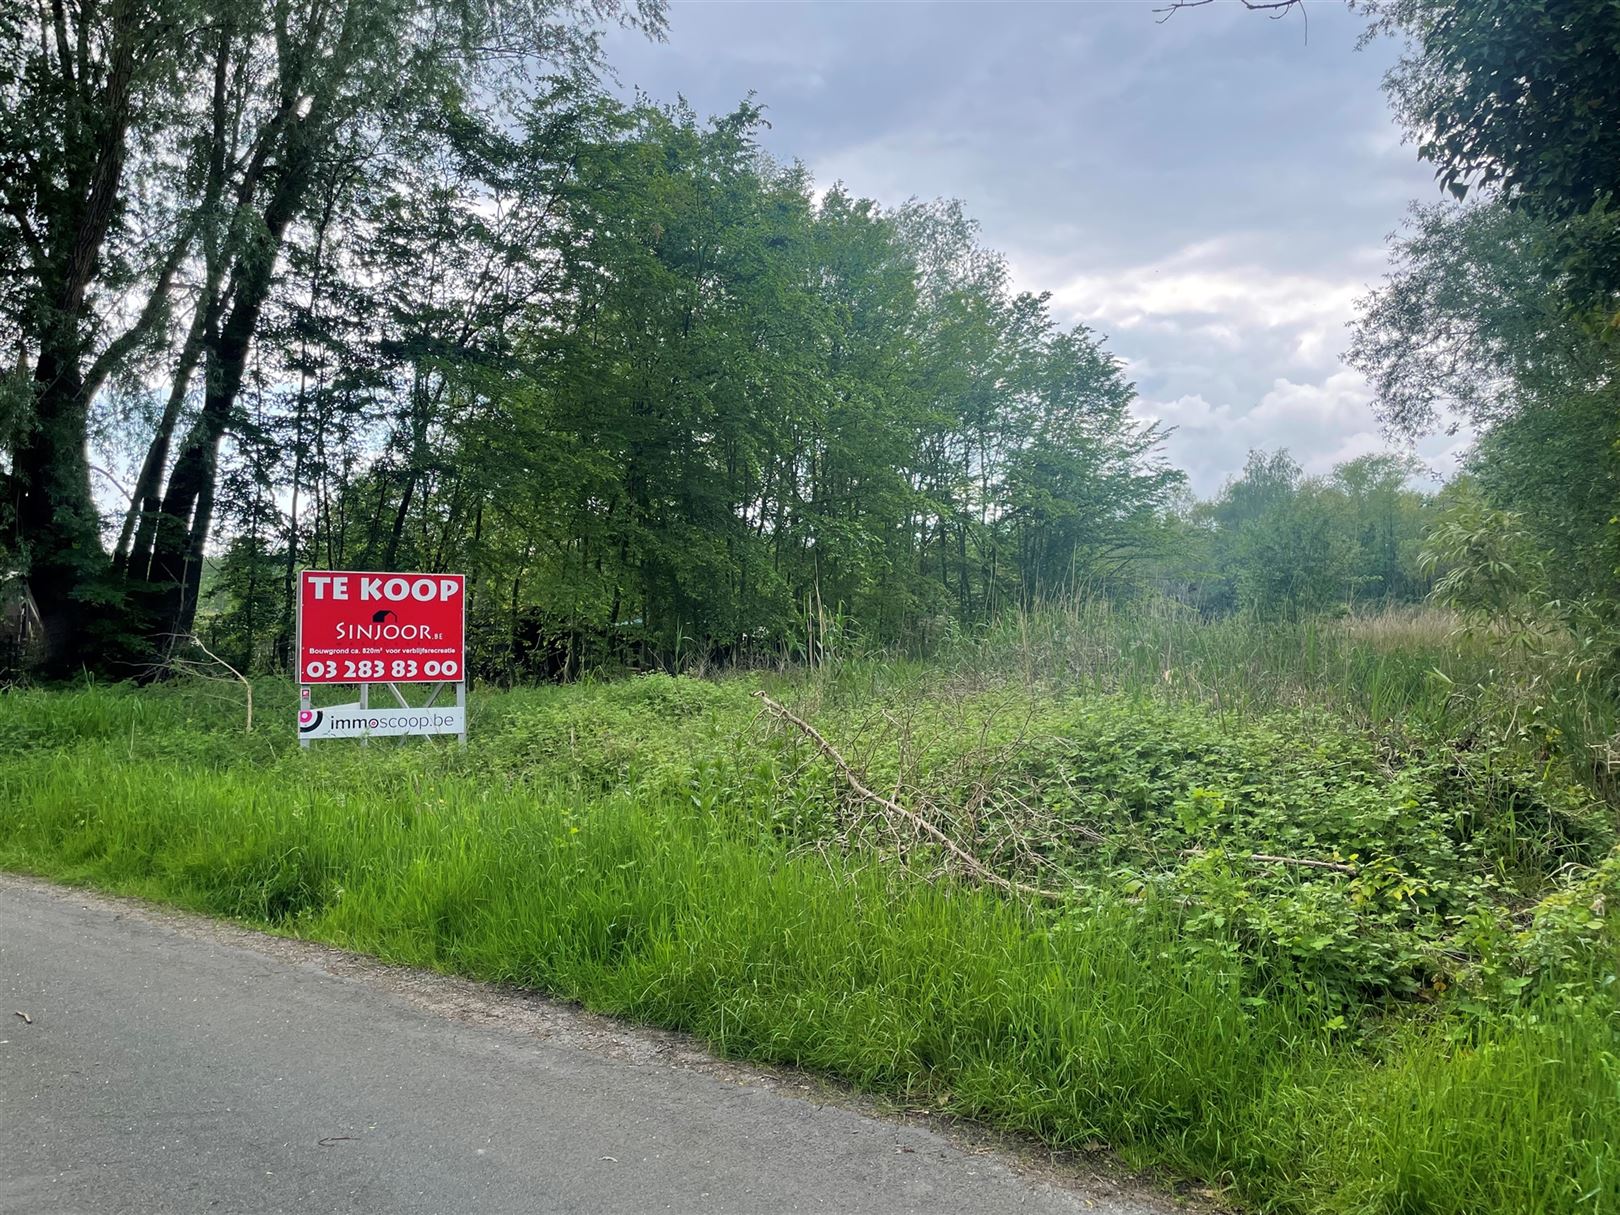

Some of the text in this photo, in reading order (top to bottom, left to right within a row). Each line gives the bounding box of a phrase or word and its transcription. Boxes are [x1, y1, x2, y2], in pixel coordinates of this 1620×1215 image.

[308, 577, 459, 601] TE KOOP
[336, 622, 443, 640] SINJOOR.BE
[309, 647, 349, 655] Bouwgrond
[306, 660, 458, 678] 03 283 83 00
[330, 714, 454, 730] immoscoop.be
